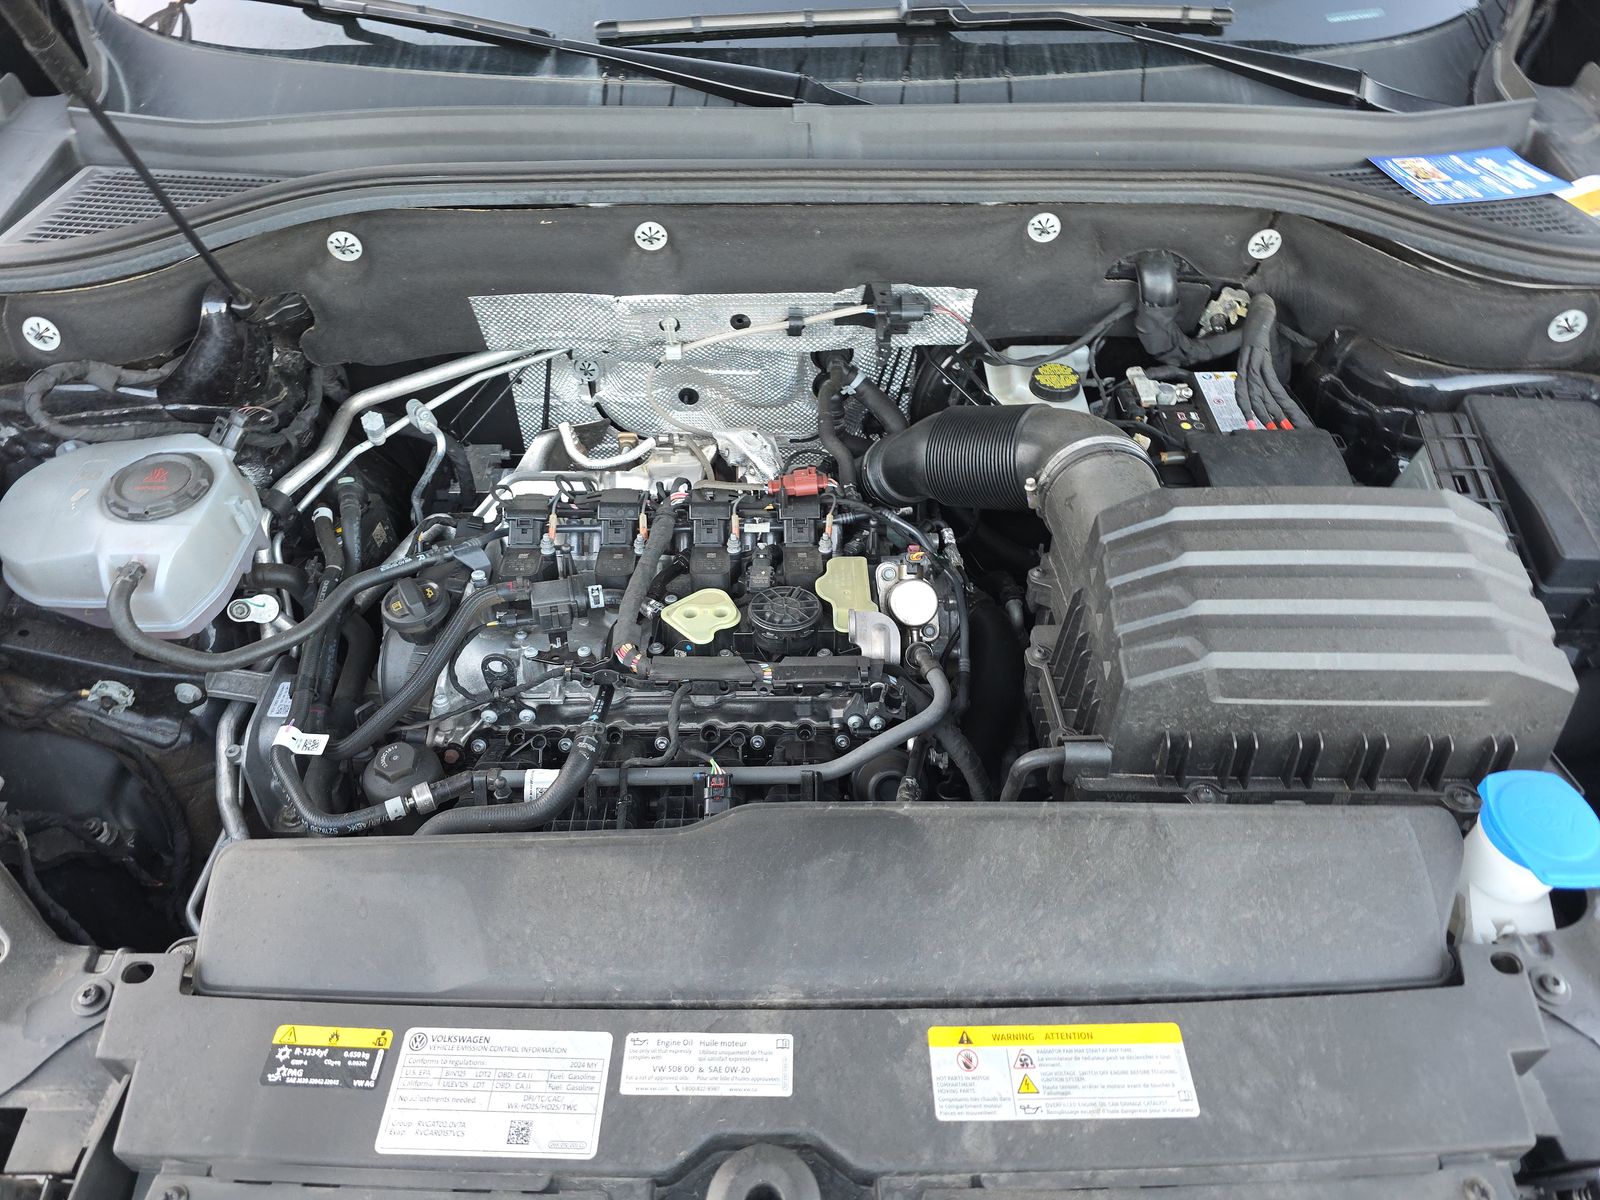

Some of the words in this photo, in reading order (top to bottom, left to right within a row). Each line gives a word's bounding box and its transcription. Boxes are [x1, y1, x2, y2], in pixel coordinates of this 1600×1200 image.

[430, 1035, 491, 1044] VOLKSWAGEN
[991, 1033, 1035, 1041] WARNING
[1044, 1031, 1094, 1040] ATTENTION
[656, 1039, 682, 1048] Engine
[699, 1039, 719, 1047] Huile
[294, 1048, 330, 1059] R-1234yf
[429, 1044, 456, 1052] VEHICLE
[521, 1047, 568, 1055] INFORMATION
[408, 1057, 439, 1065] Conforms
[287, 1069, 304, 1077] PAG
[652, 1065, 667, 1073] VW
[668, 1065, 683, 1073] 508
[684, 1065, 695, 1073] 00
[724, 1066, 751, 1074] 0W-20
[568, 1073, 596, 1081] Gasoline
[566, 1084, 594, 1092] Gasoline
